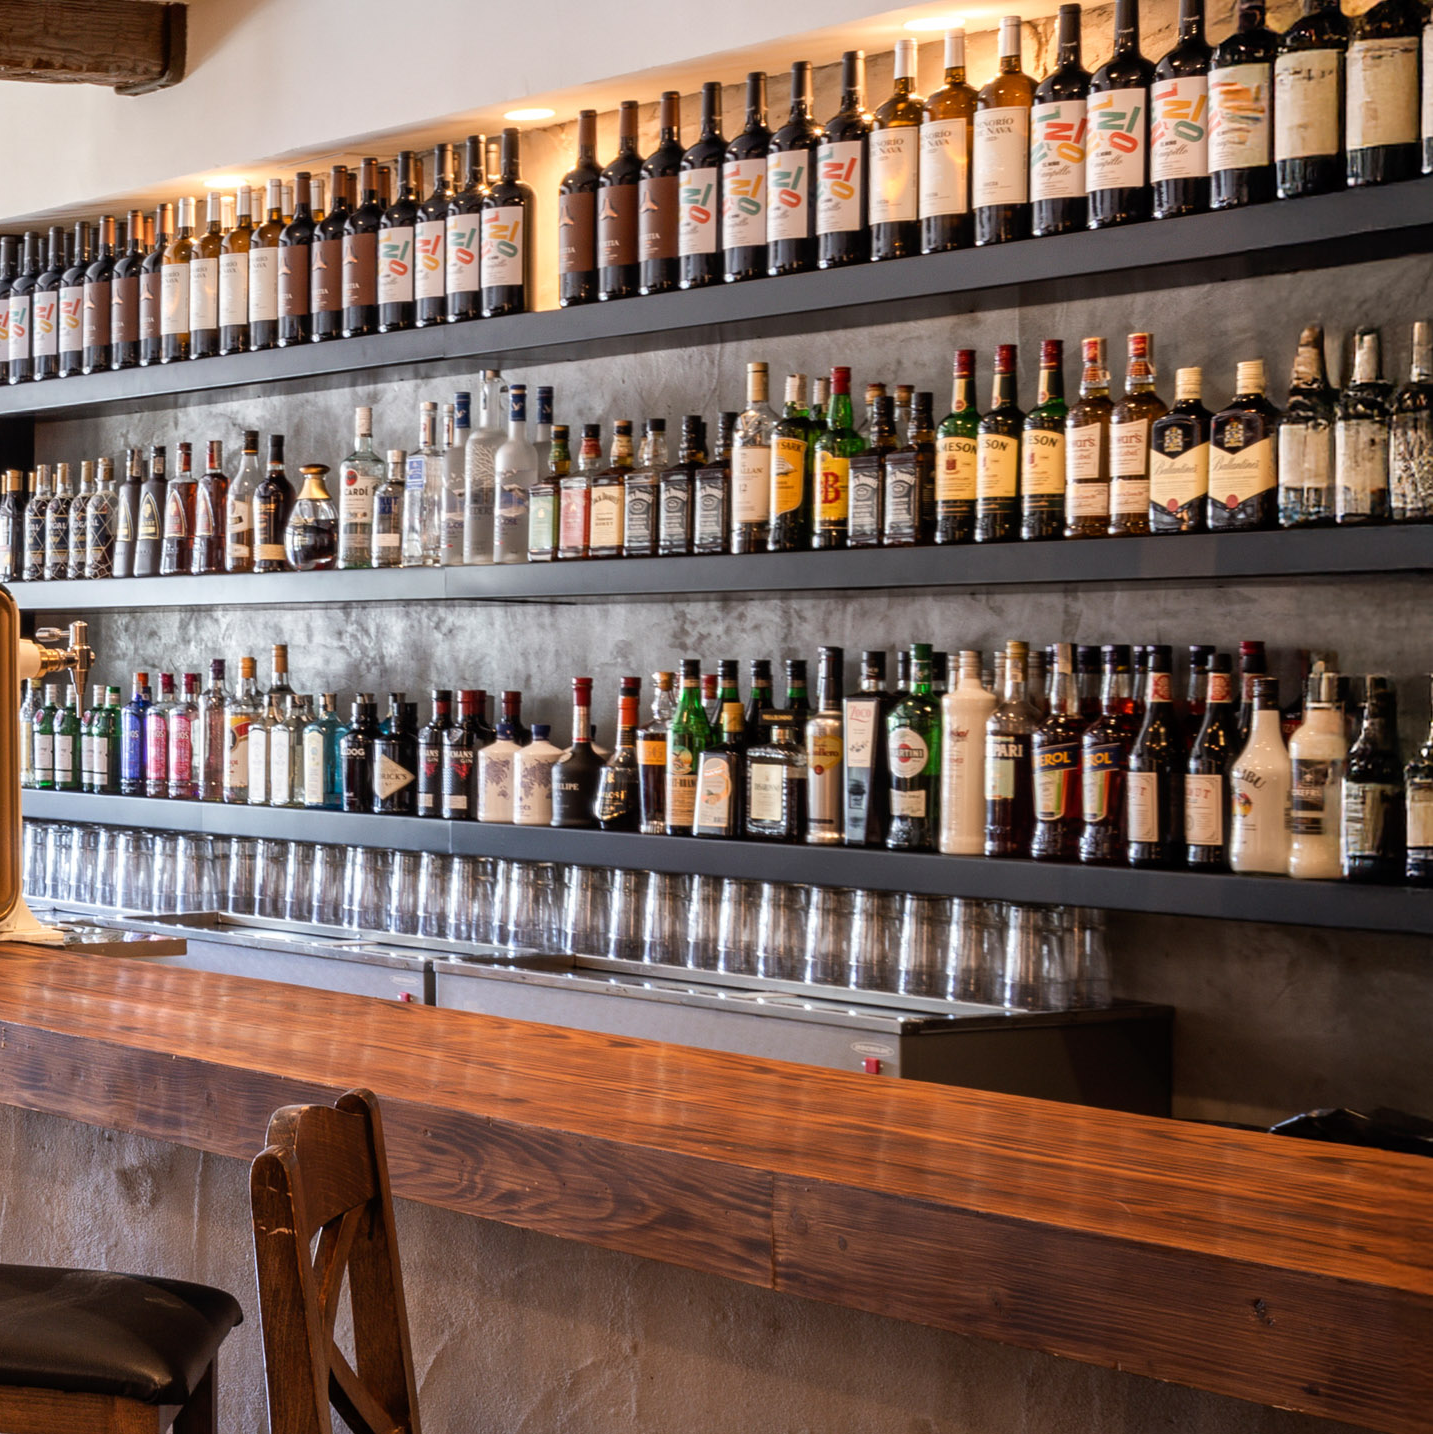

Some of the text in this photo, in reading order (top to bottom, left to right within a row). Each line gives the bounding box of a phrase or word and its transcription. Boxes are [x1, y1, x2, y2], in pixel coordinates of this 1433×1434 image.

[979, 439, 1009, 451] ESON
[1024, 435, 1060, 448] ESON
[936, 442, 977, 455] AMESON
[343, 486, 369, 496] CARDÍ
[993, 744, 1023, 757] PARI
[1037, 752, 1071, 767] EROL
[1086, 752, 1113, 767] ROL
[556, 782, 580, 791] ELIPE
